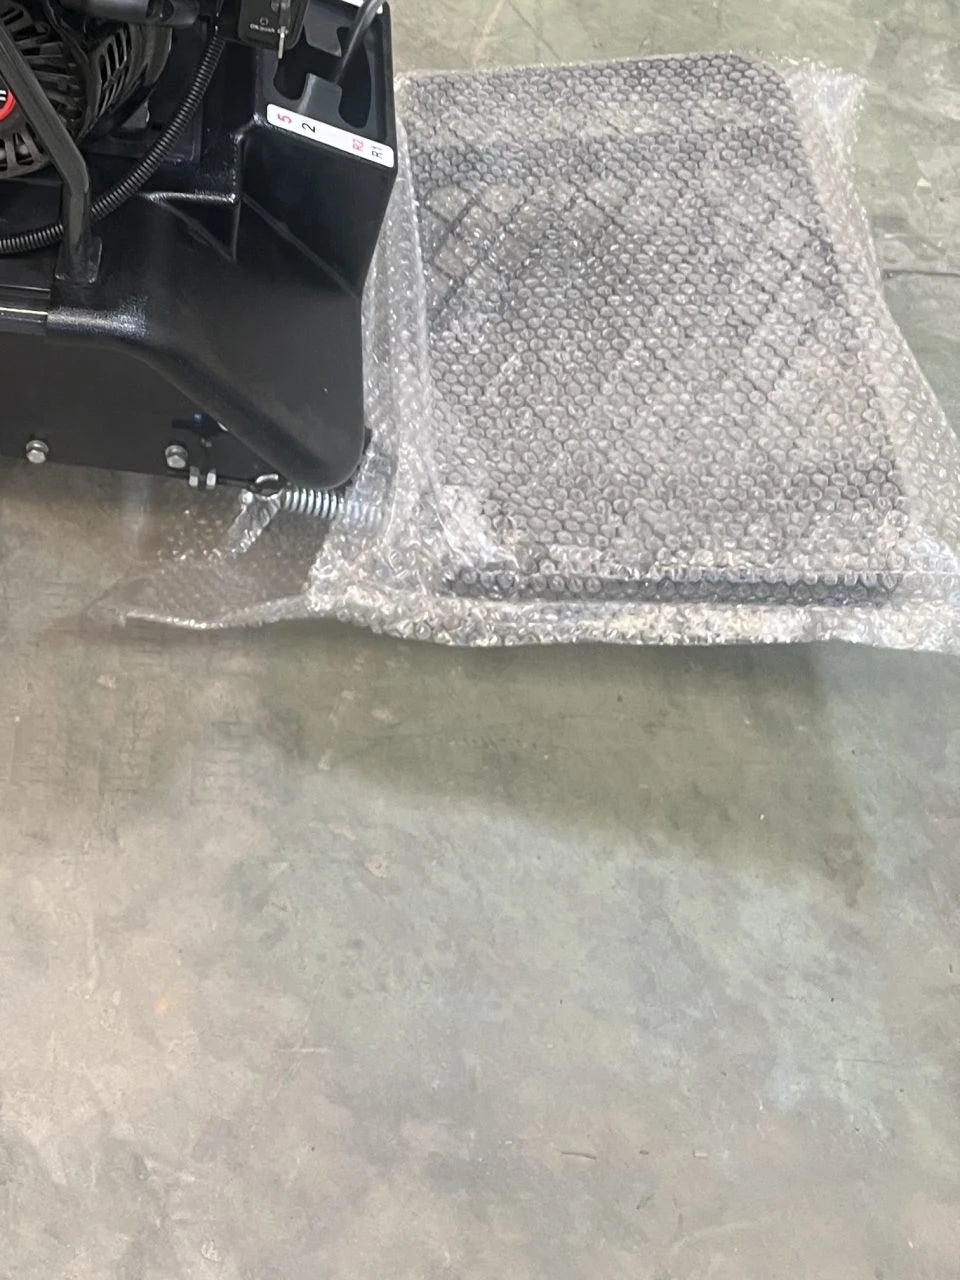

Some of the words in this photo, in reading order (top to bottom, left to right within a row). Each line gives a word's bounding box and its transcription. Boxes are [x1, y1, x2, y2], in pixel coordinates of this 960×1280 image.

[277, 113, 292, 124] 5
[301, 122, 316, 133] 2
[352, 138, 365, 152] R2
[371, 145, 383, 160] R1
